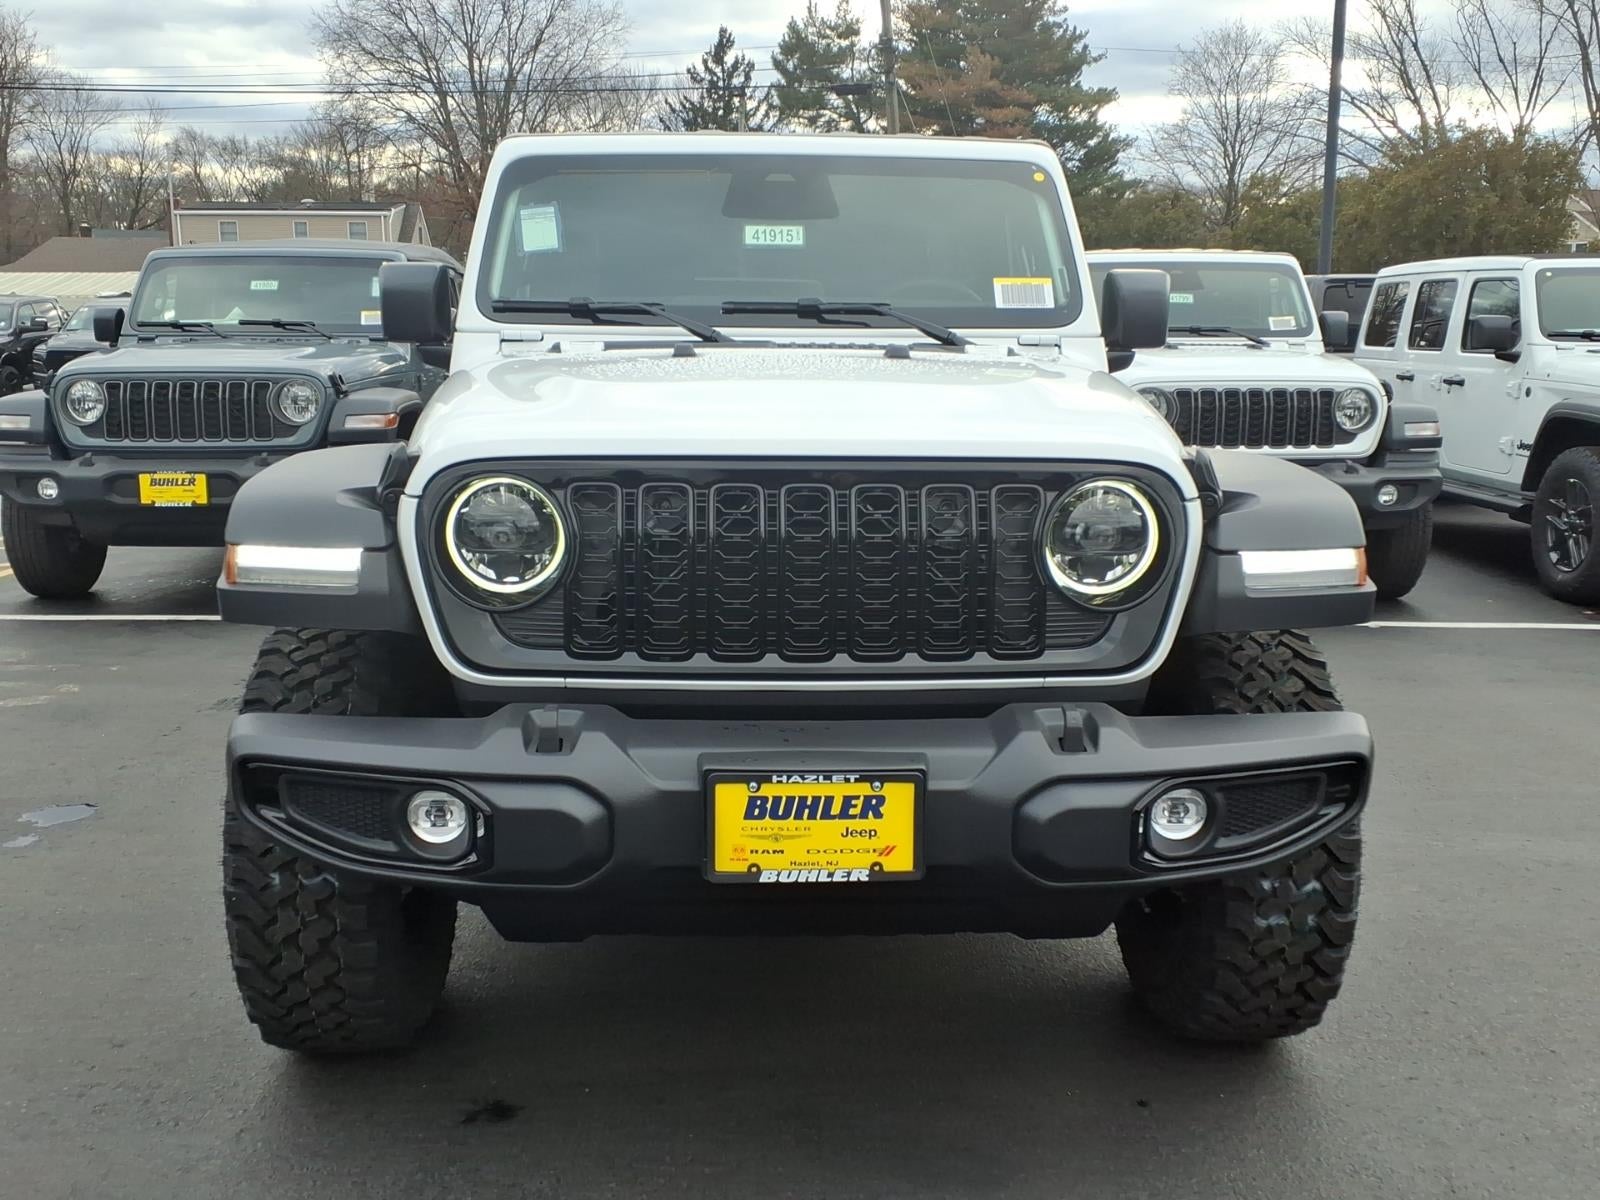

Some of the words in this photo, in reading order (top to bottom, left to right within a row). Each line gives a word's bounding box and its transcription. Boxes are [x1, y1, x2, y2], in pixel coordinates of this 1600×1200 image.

[751, 228, 794, 242] 41915
[1517, 440, 1533, 451] Jee
[150, 478, 197, 487] BUHLER
[772, 774, 860, 784] HAZLET
[743, 795, 887, 821] BUHLER
[841, 827, 878, 840] Jeep
[759, 869, 870, 883] BUHLER
